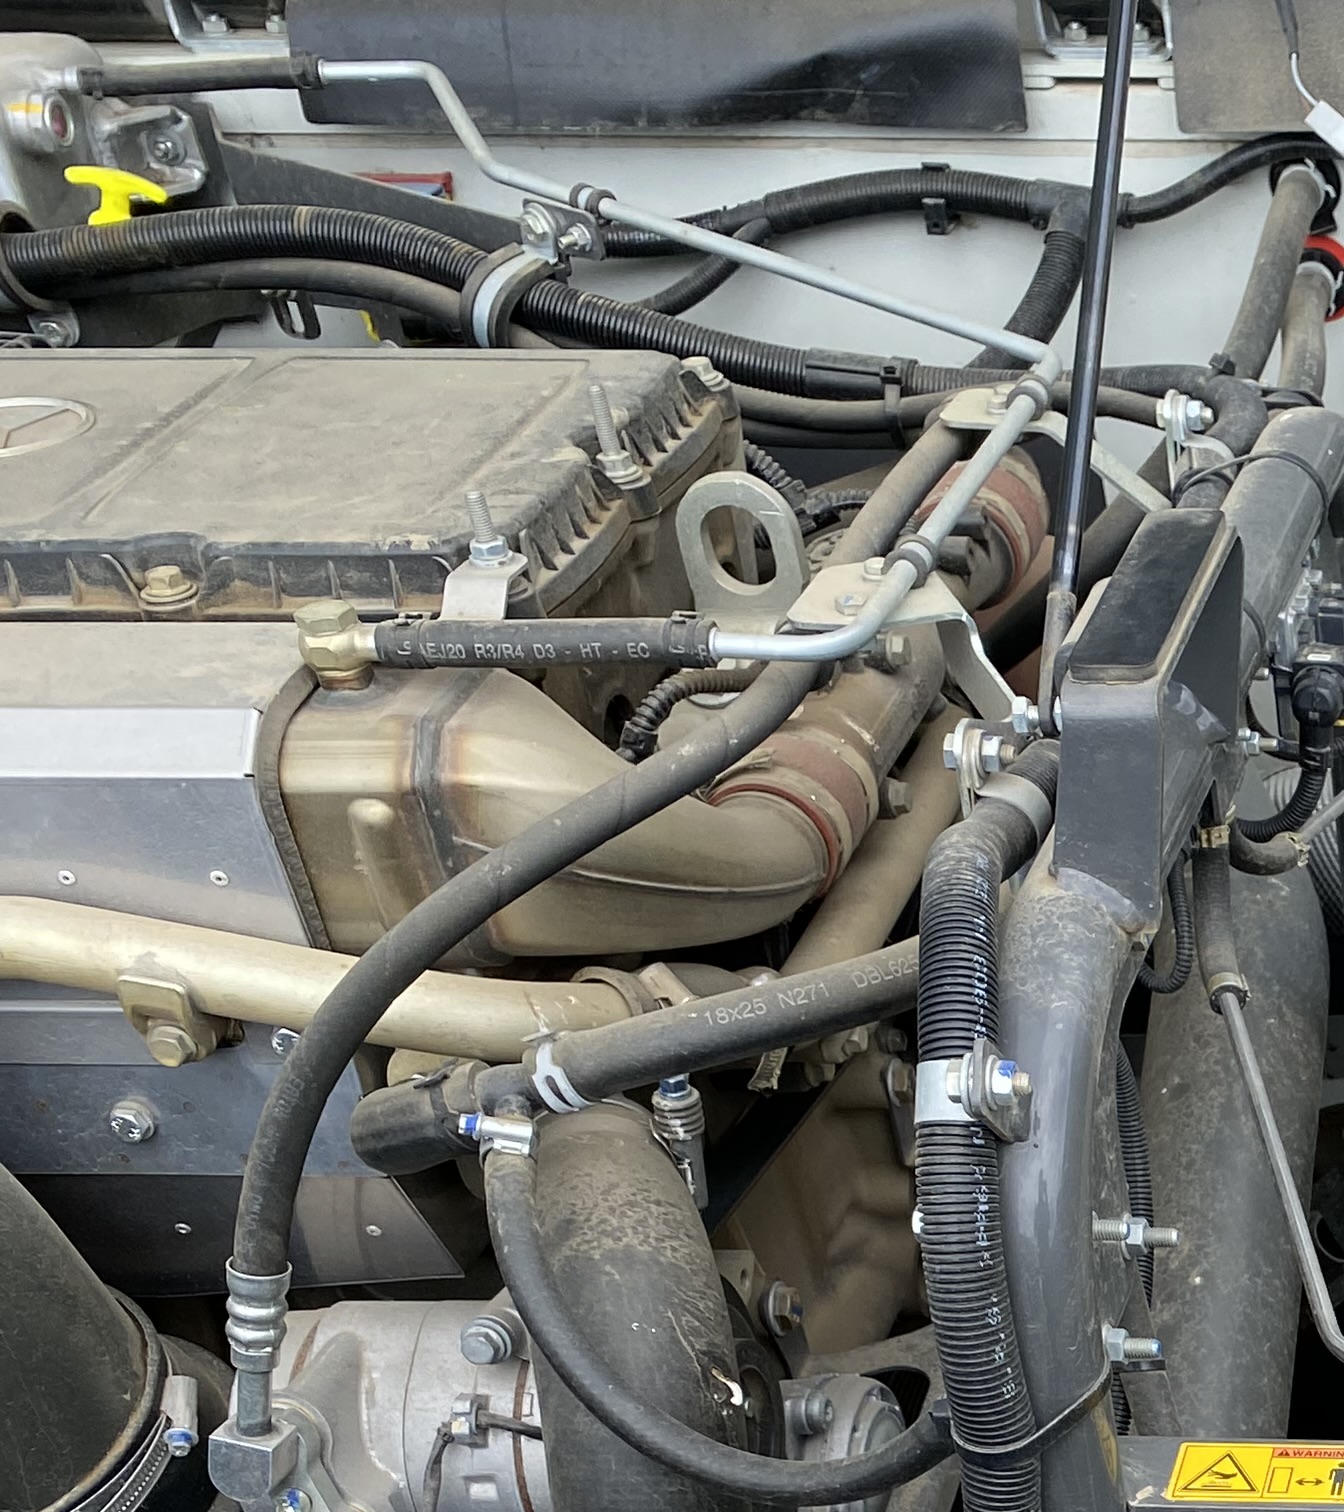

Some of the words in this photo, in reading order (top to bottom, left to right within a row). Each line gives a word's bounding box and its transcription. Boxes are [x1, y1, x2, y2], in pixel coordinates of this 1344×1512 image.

[474, 643, 525, 659] R3/R4
[533, 643, 556, 659] D3
[580, 642, 601, 659] HT
[627, 642, 650, 658] EC
[704, 999, 768, 1026] 18x25
[776, 982, 830, 1009] N271
